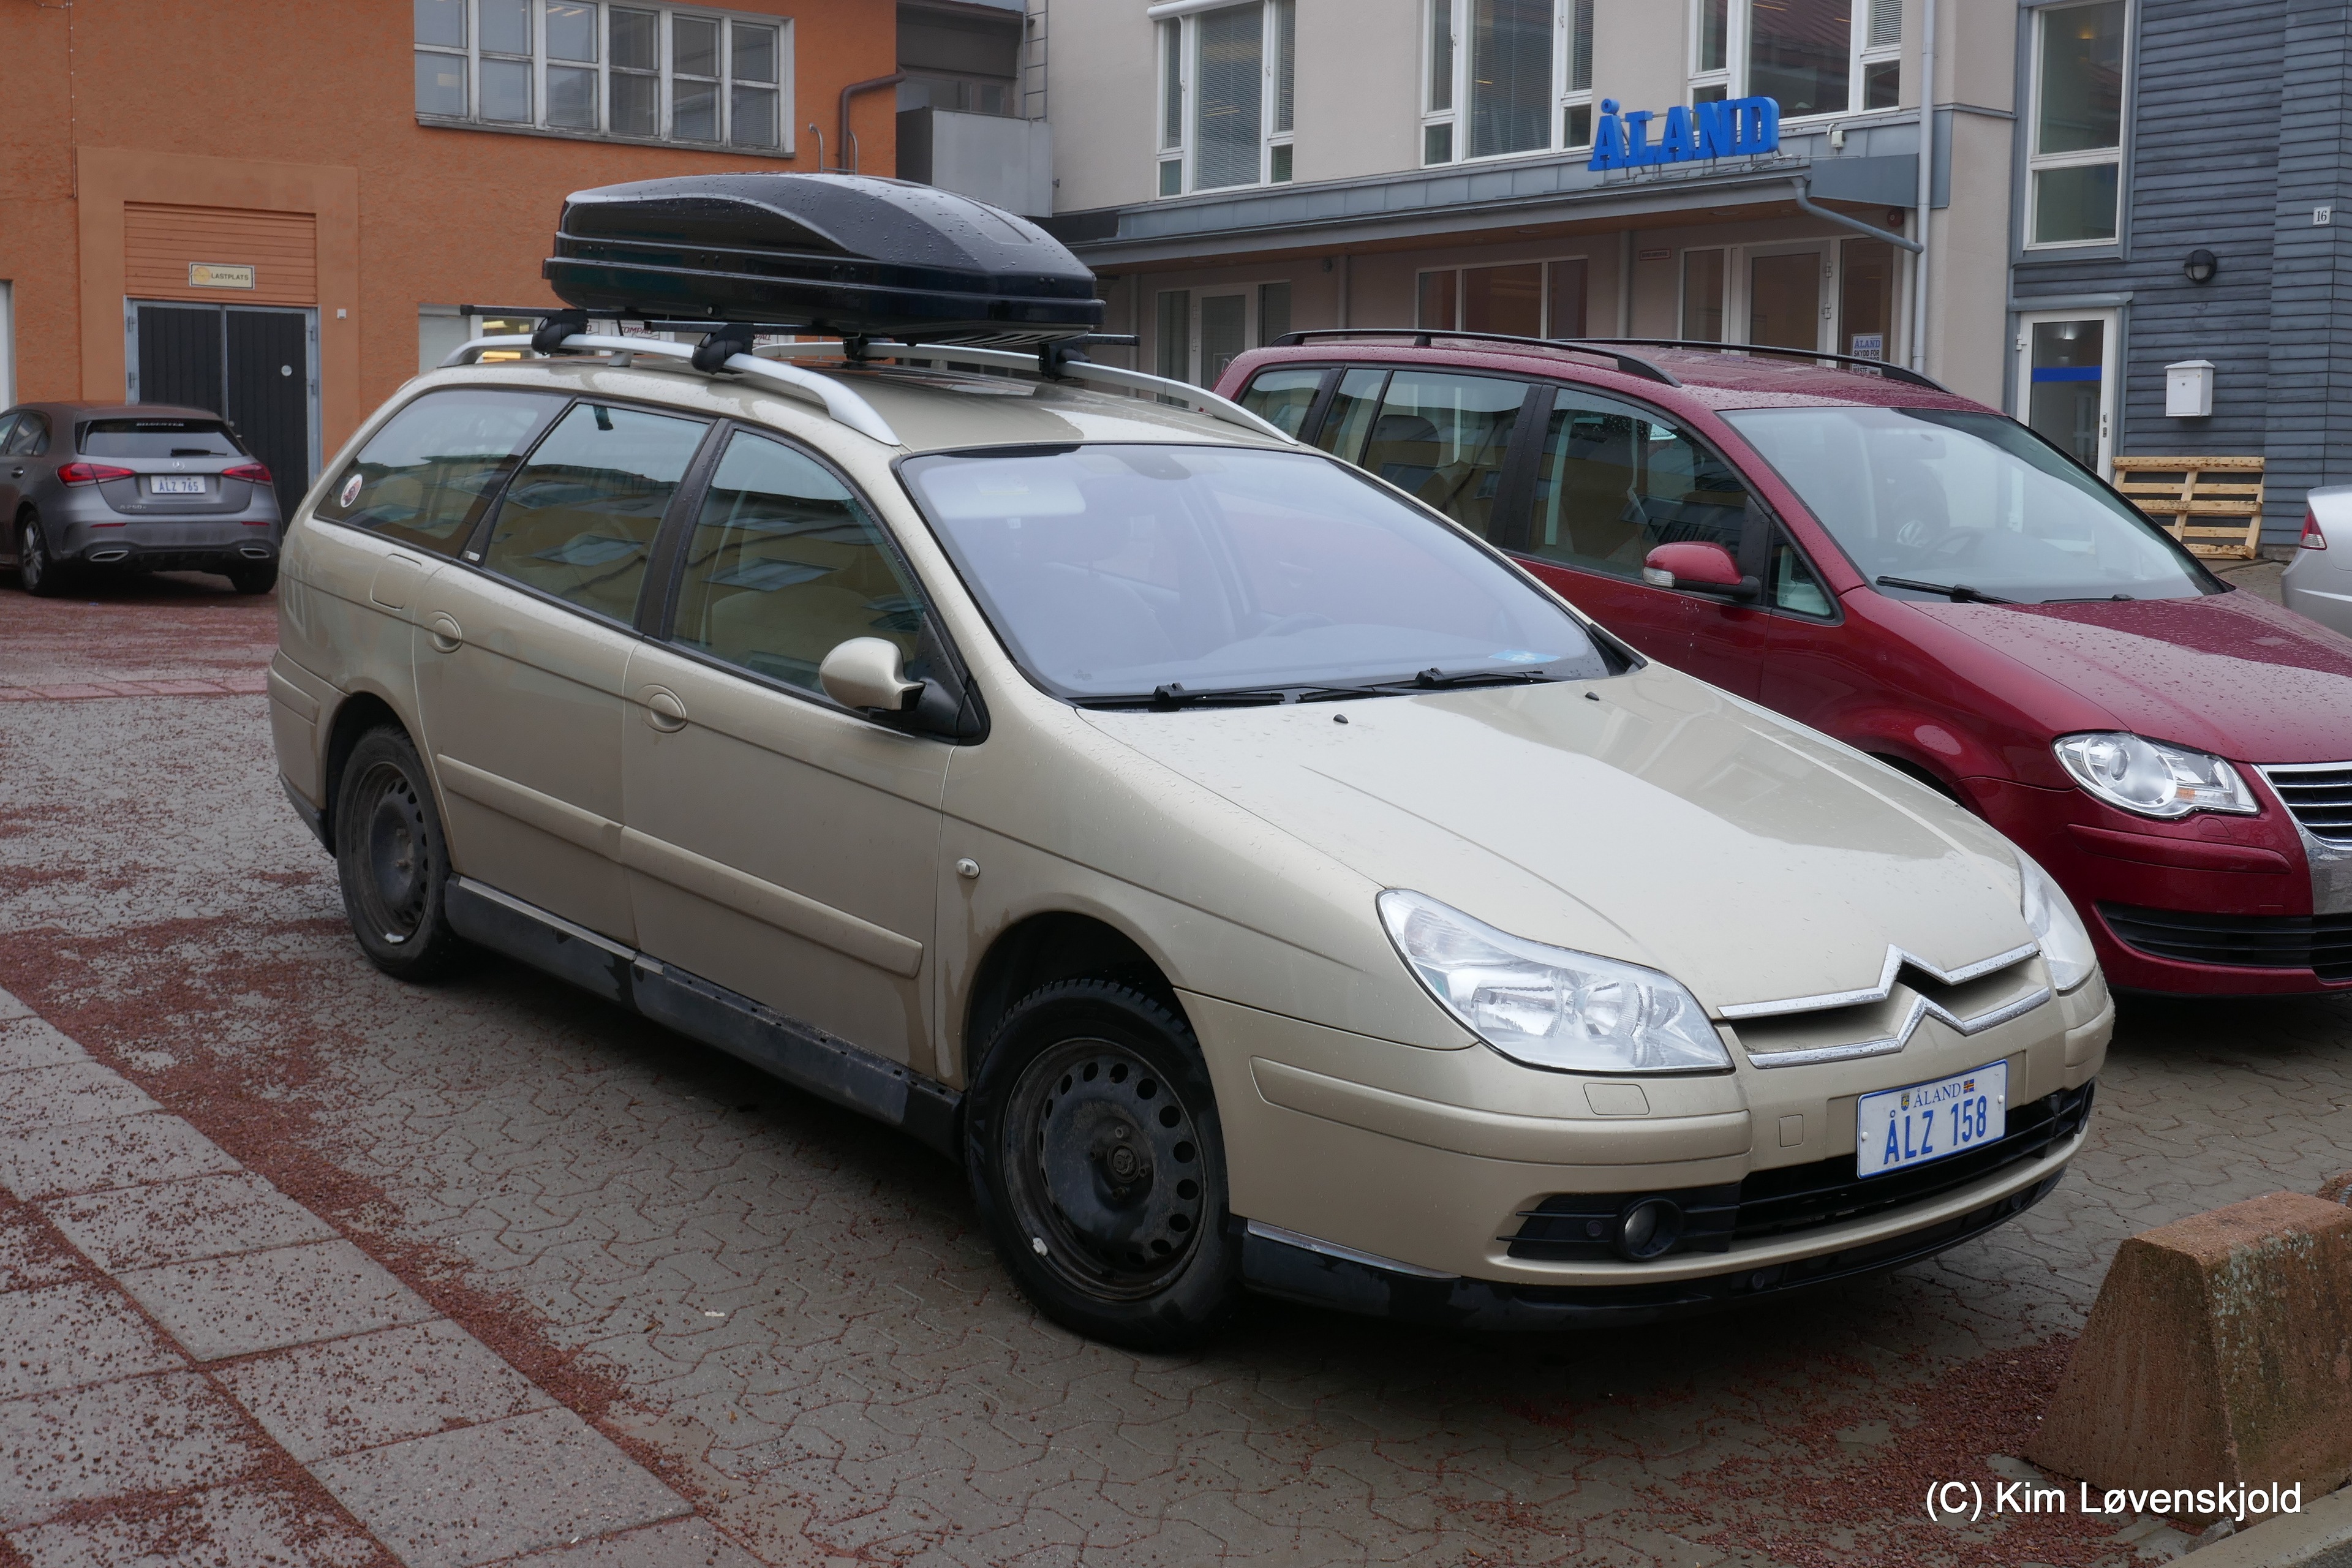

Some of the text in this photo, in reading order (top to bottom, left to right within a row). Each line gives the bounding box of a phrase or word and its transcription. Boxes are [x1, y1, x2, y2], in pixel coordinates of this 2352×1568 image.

[1588, 97, 1779, 171] ÅLAND
[2316, 210, 2327, 222] 16
[1854, 338, 1880, 348] ÅLAND
[182, 481, 198, 491] 765
[1913, 1083, 1961, 1107] ÅLAND
[1883, 1095, 1987, 1164] ÅLZ 158
